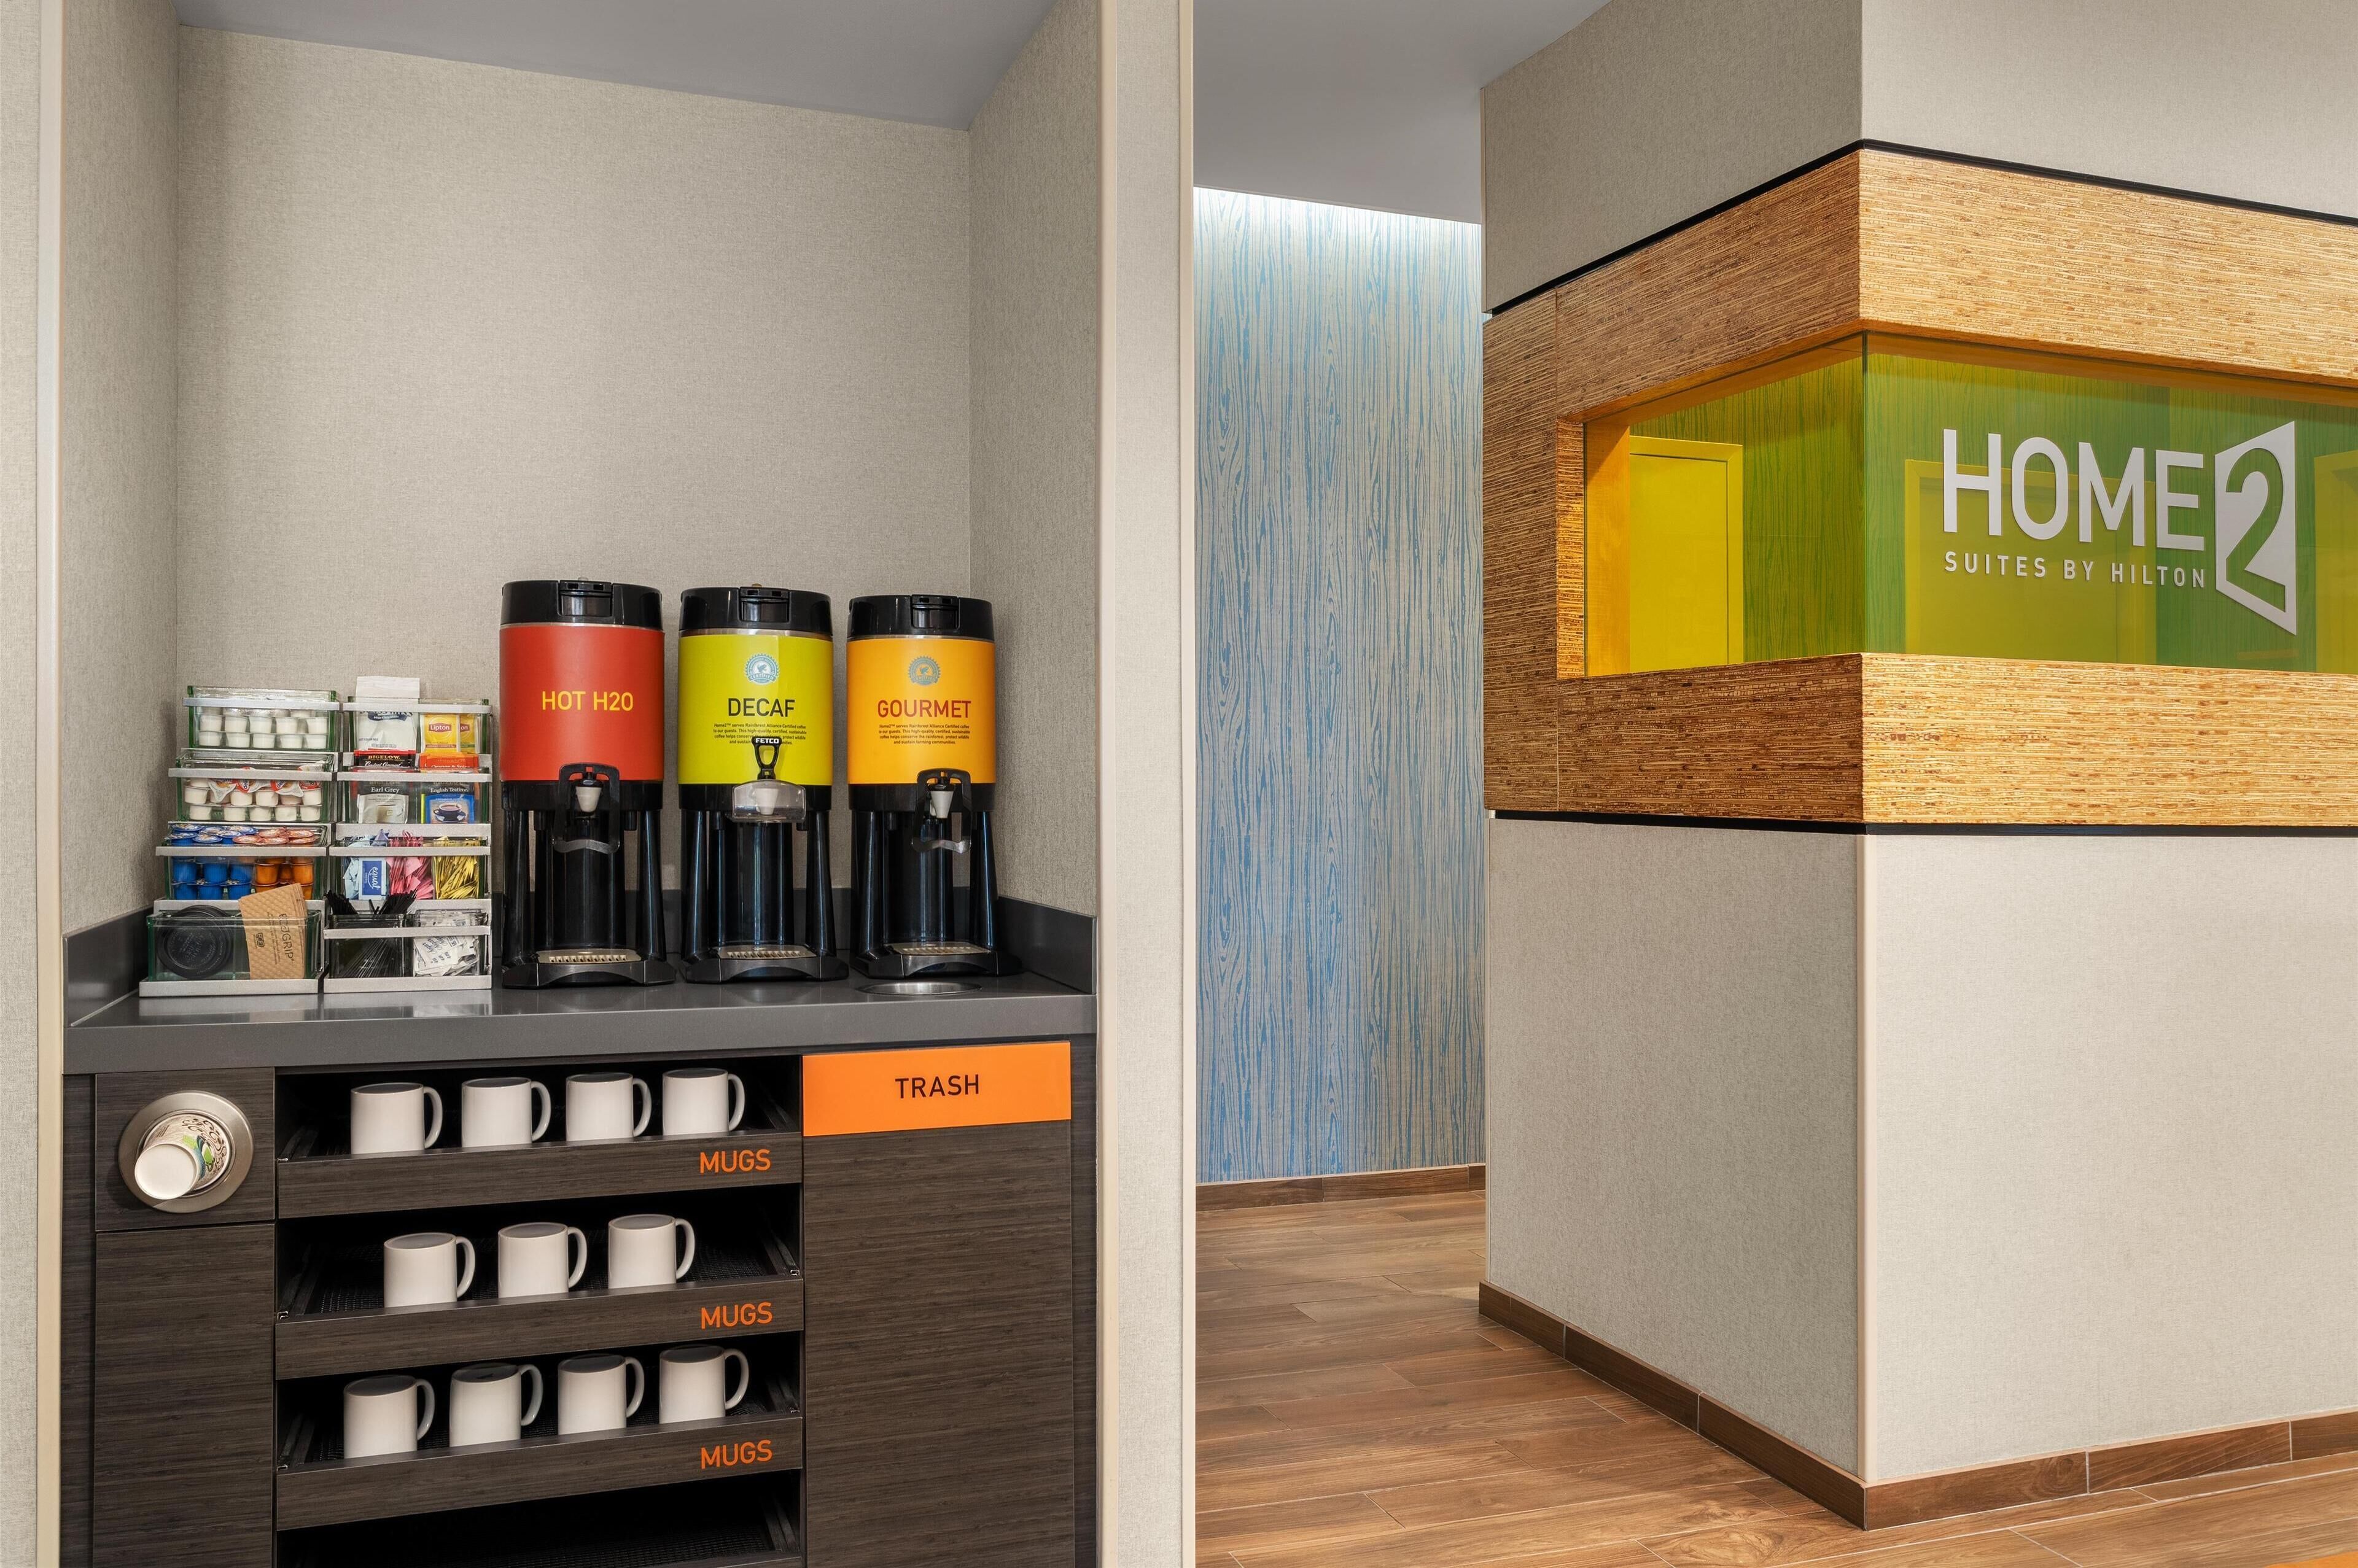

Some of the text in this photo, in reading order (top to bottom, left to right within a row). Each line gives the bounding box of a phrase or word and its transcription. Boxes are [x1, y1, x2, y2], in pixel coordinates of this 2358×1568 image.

[1945, 551, 2205, 588] SUITES BY HILTON
[542, 691, 586, 710] HOT
[728, 697, 795, 718] DECAF
[877, 699, 971, 718] GOURMET
[369, 866, 381, 889] equal
[895, 1074, 980, 1099] TRASH
[699, 1149, 771, 1174] MUGS
[701, 1302, 773, 1329] MUGS
[701, 1440, 772, 1469] MUGS
